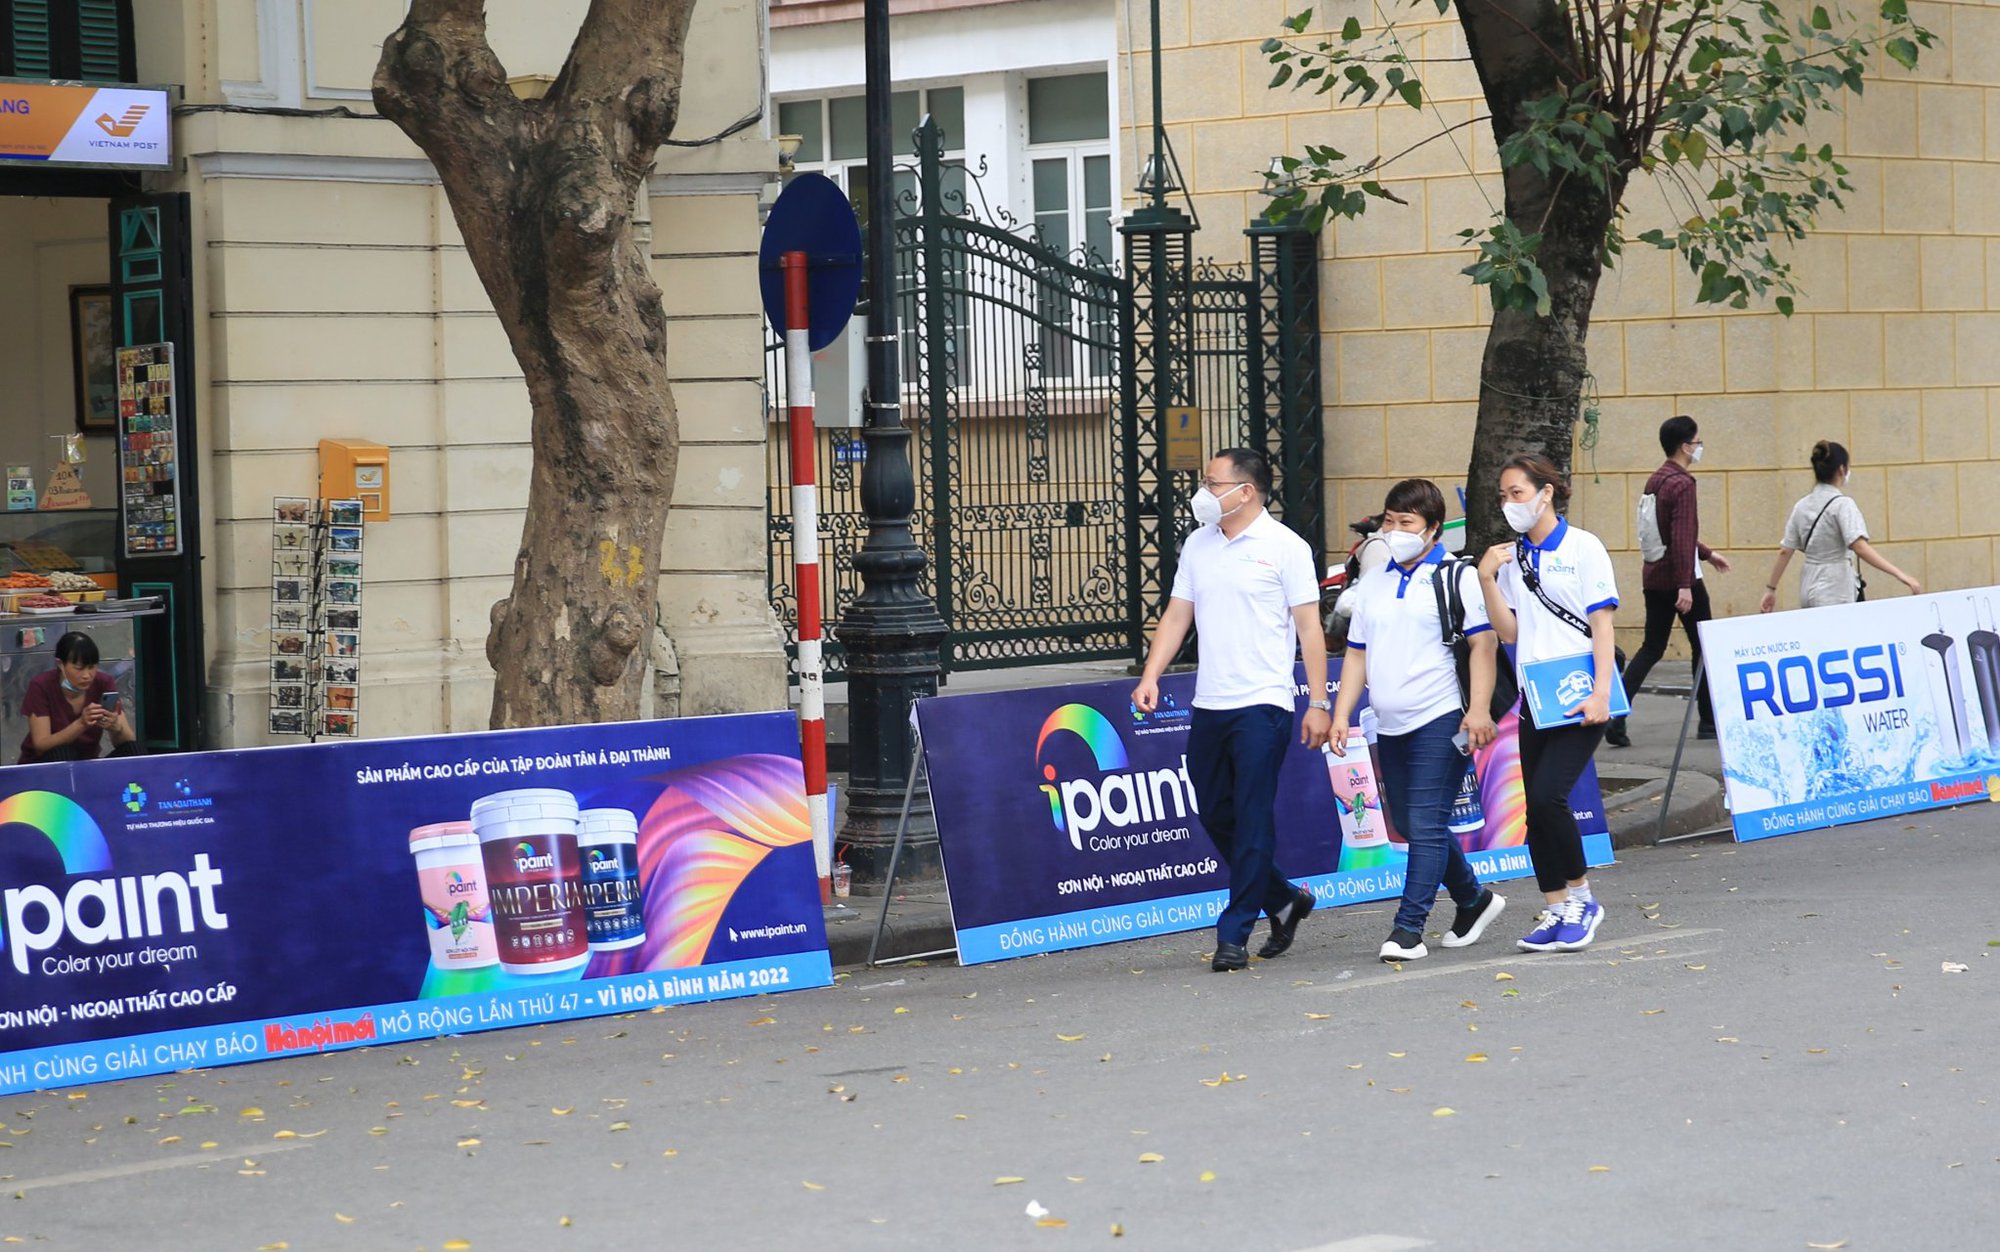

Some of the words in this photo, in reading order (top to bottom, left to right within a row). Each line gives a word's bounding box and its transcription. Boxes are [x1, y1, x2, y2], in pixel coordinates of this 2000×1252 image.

[89, 140, 130, 149] VIETNAM
[133, 142, 159, 150] POST
[1736, 643, 1905, 721] ROSSI
[1863, 708, 1910, 734] WATER
[356, 766, 383, 785] SẢN
[385, 761, 422, 783] PHẨM
[424, 765, 452, 780] CAO
[454, 757, 481, 777] CẤP
[482, 756, 509, 775] CỦA
[510, 755, 533, 776] TẬP
[535, 752, 573, 771] ĐOÀN
[573, 750, 597, 767] TÂN
[610, 750, 631, 768] ĐẠI
[631, 744, 672, 763] THÀNH
[1797, 807, 1825, 826] HÀNH
[1827, 801, 1857, 820] CÙNG
[1858, 794, 1879, 814] GIẢI
[1908, 788, 1929, 805] BÁO
[1090, 835, 1121, 852] Color
[1123, 832, 1149, 850] your
[1151, 827, 1190, 844] dream
[1057, 879, 1083, 895] SƠN
[1083, 874, 1105, 892] NỘI
[1110, 869, 1146, 887] NGOẠI
[1146, 862, 1173, 882] THẤT
[1174, 863, 1197, 878] CAO
[1197, 857, 1219, 875] CẤP
[1000, 926, 1045, 950] ĐỒNG
[1049, 920, 1088, 943] HÀNH
[1091, 914, 1133, 935] CÙNG
[1136, 905, 1165, 927] GIẢI
[1167, 903, 1202, 924] CHẠY
[1314, 878, 1335, 901] MỞ
[1339, 876, 1376, 897] RỘNG
[1377, 870, 1401, 891] LẦN
[1472, 855, 1496, 876] HOÀ
[1499, 854, 1527, 873] BÌNH
[740, 922, 808, 940] www.ipaint.vn
[42, 956, 91, 976] Color
[95, 950, 134, 974] your
[139, 945, 198, 964] dream
[0, 1010, 23, 1029] ƠN
[27, 1005, 59, 1027] NỘI
[71, 998, 124, 1019] NGOẠI
[125, 989, 167, 1013] THẤT
[170, 989, 203, 1008] CAO
[205, 981, 237, 1003] CẤP
[34, 1053, 98, 1081] CÙNG
[105, 1043, 147, 1070] GIẢI
[154, 1039, 207, 1065] CHẠY
[216, 1031, 257, 1057] BÁO
[380, 1009, 412, 1035] MỞ
[418, 1006, 473, 1032] RỘNG
[479, 998, 514, 1023] LẦN
[519, 993, 554, 1018] THỨ
[560, 993, 579, 1012] 47
[597, 985, 616, 1008] VÌ
[621, 979, 660, 1004] HOÀ
[664, 974, 704, 998] BÌNH
[707, 969, 746, 994] NĂM
[749, 966, 790, 987] 2022
